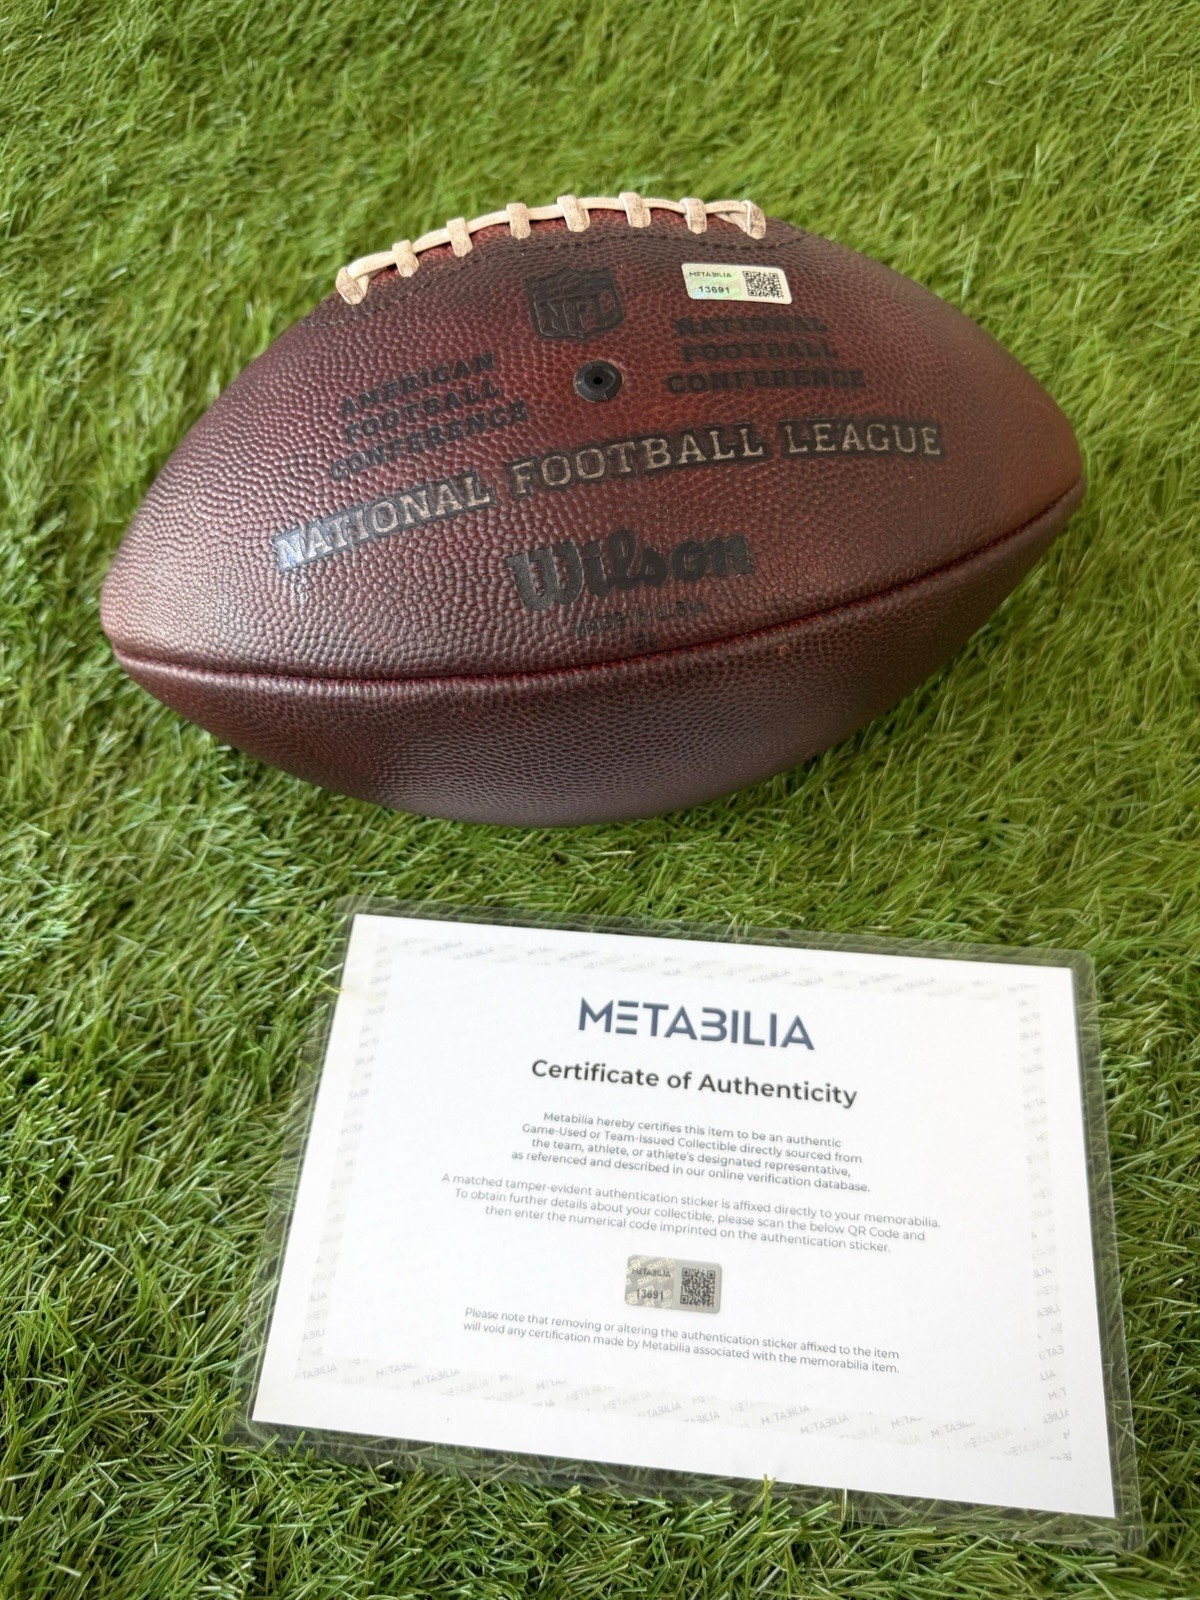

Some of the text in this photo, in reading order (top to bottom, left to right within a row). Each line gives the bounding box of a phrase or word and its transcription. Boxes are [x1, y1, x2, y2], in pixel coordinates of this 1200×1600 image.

[676, 317, 828, 336] NATIONAL
[681, 341, 838, 362] FOOTBALL
[342, 353, 494, 416] AMERICAN
[667, 369, 866, 393] CONFERENCE
[345, 380, 500, 442] FOOTBALL
[331, 400, 528, 482] CONFERENCE
[273, 418, 942, 572] NATIONAL FOOTBALL LEAGUE
[505, 530, 752, 610] Wilson
[578, 997, 815, 1050] METABILIA
[531, 1058, 857, 1109] Certificate of Authenticity
[521, 1123, 863, 1164] Game-Used or Team-Issued Collectible directly sourced from
[543, 1111, 842, 1148] Metabilia hereby certifies this item to be an authentic
[511, 1151, 870, 1193] as referenced and described in our online verification database.
[531, 1137, 851, 1180] the team, athlete, or athlete's designated representative,
[441, 1172, 941, 1228] A matched tamper-evident authentication sticker is affixed directly to your memorabilia.
[455, 1187, 926, 1241] To obtain further details about your collectible, please scan the below QR Code and
[485, 1204, 891, 1253] then enter the numerical code imprinted on the authentication sticker.
[636, 1288, 664, 1300] 13691
[463, 1320, 900, 1374] will void any certification made by Metabilia associated with the memorabilia item.
[464, 1306, 900, 1360] Please note that removing or altering the authentication sticker affixed to the item
